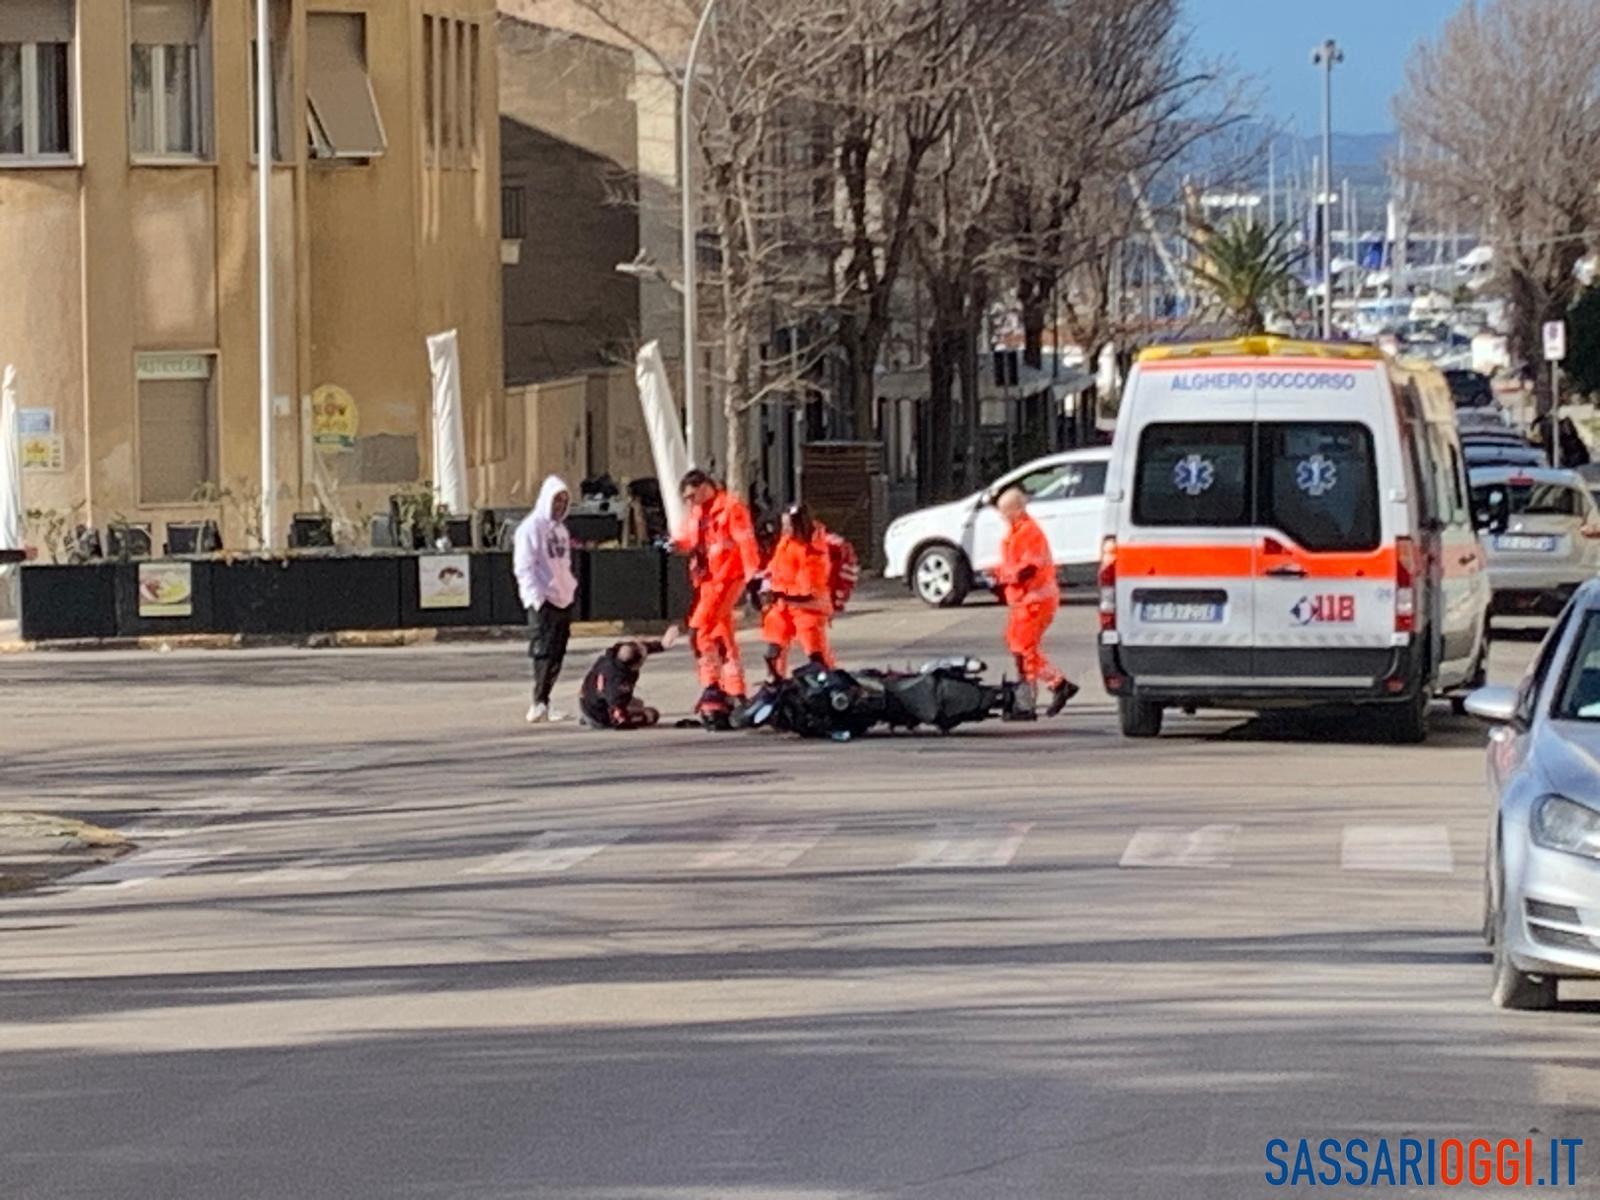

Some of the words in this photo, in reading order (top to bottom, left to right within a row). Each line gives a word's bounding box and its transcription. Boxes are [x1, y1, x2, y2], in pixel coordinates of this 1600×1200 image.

[1171, 373, 1252, 391] ALGHERO
[1255, 372, 1356, 390] SOCCORSO
[1314, 594, 1355, 622] 118
